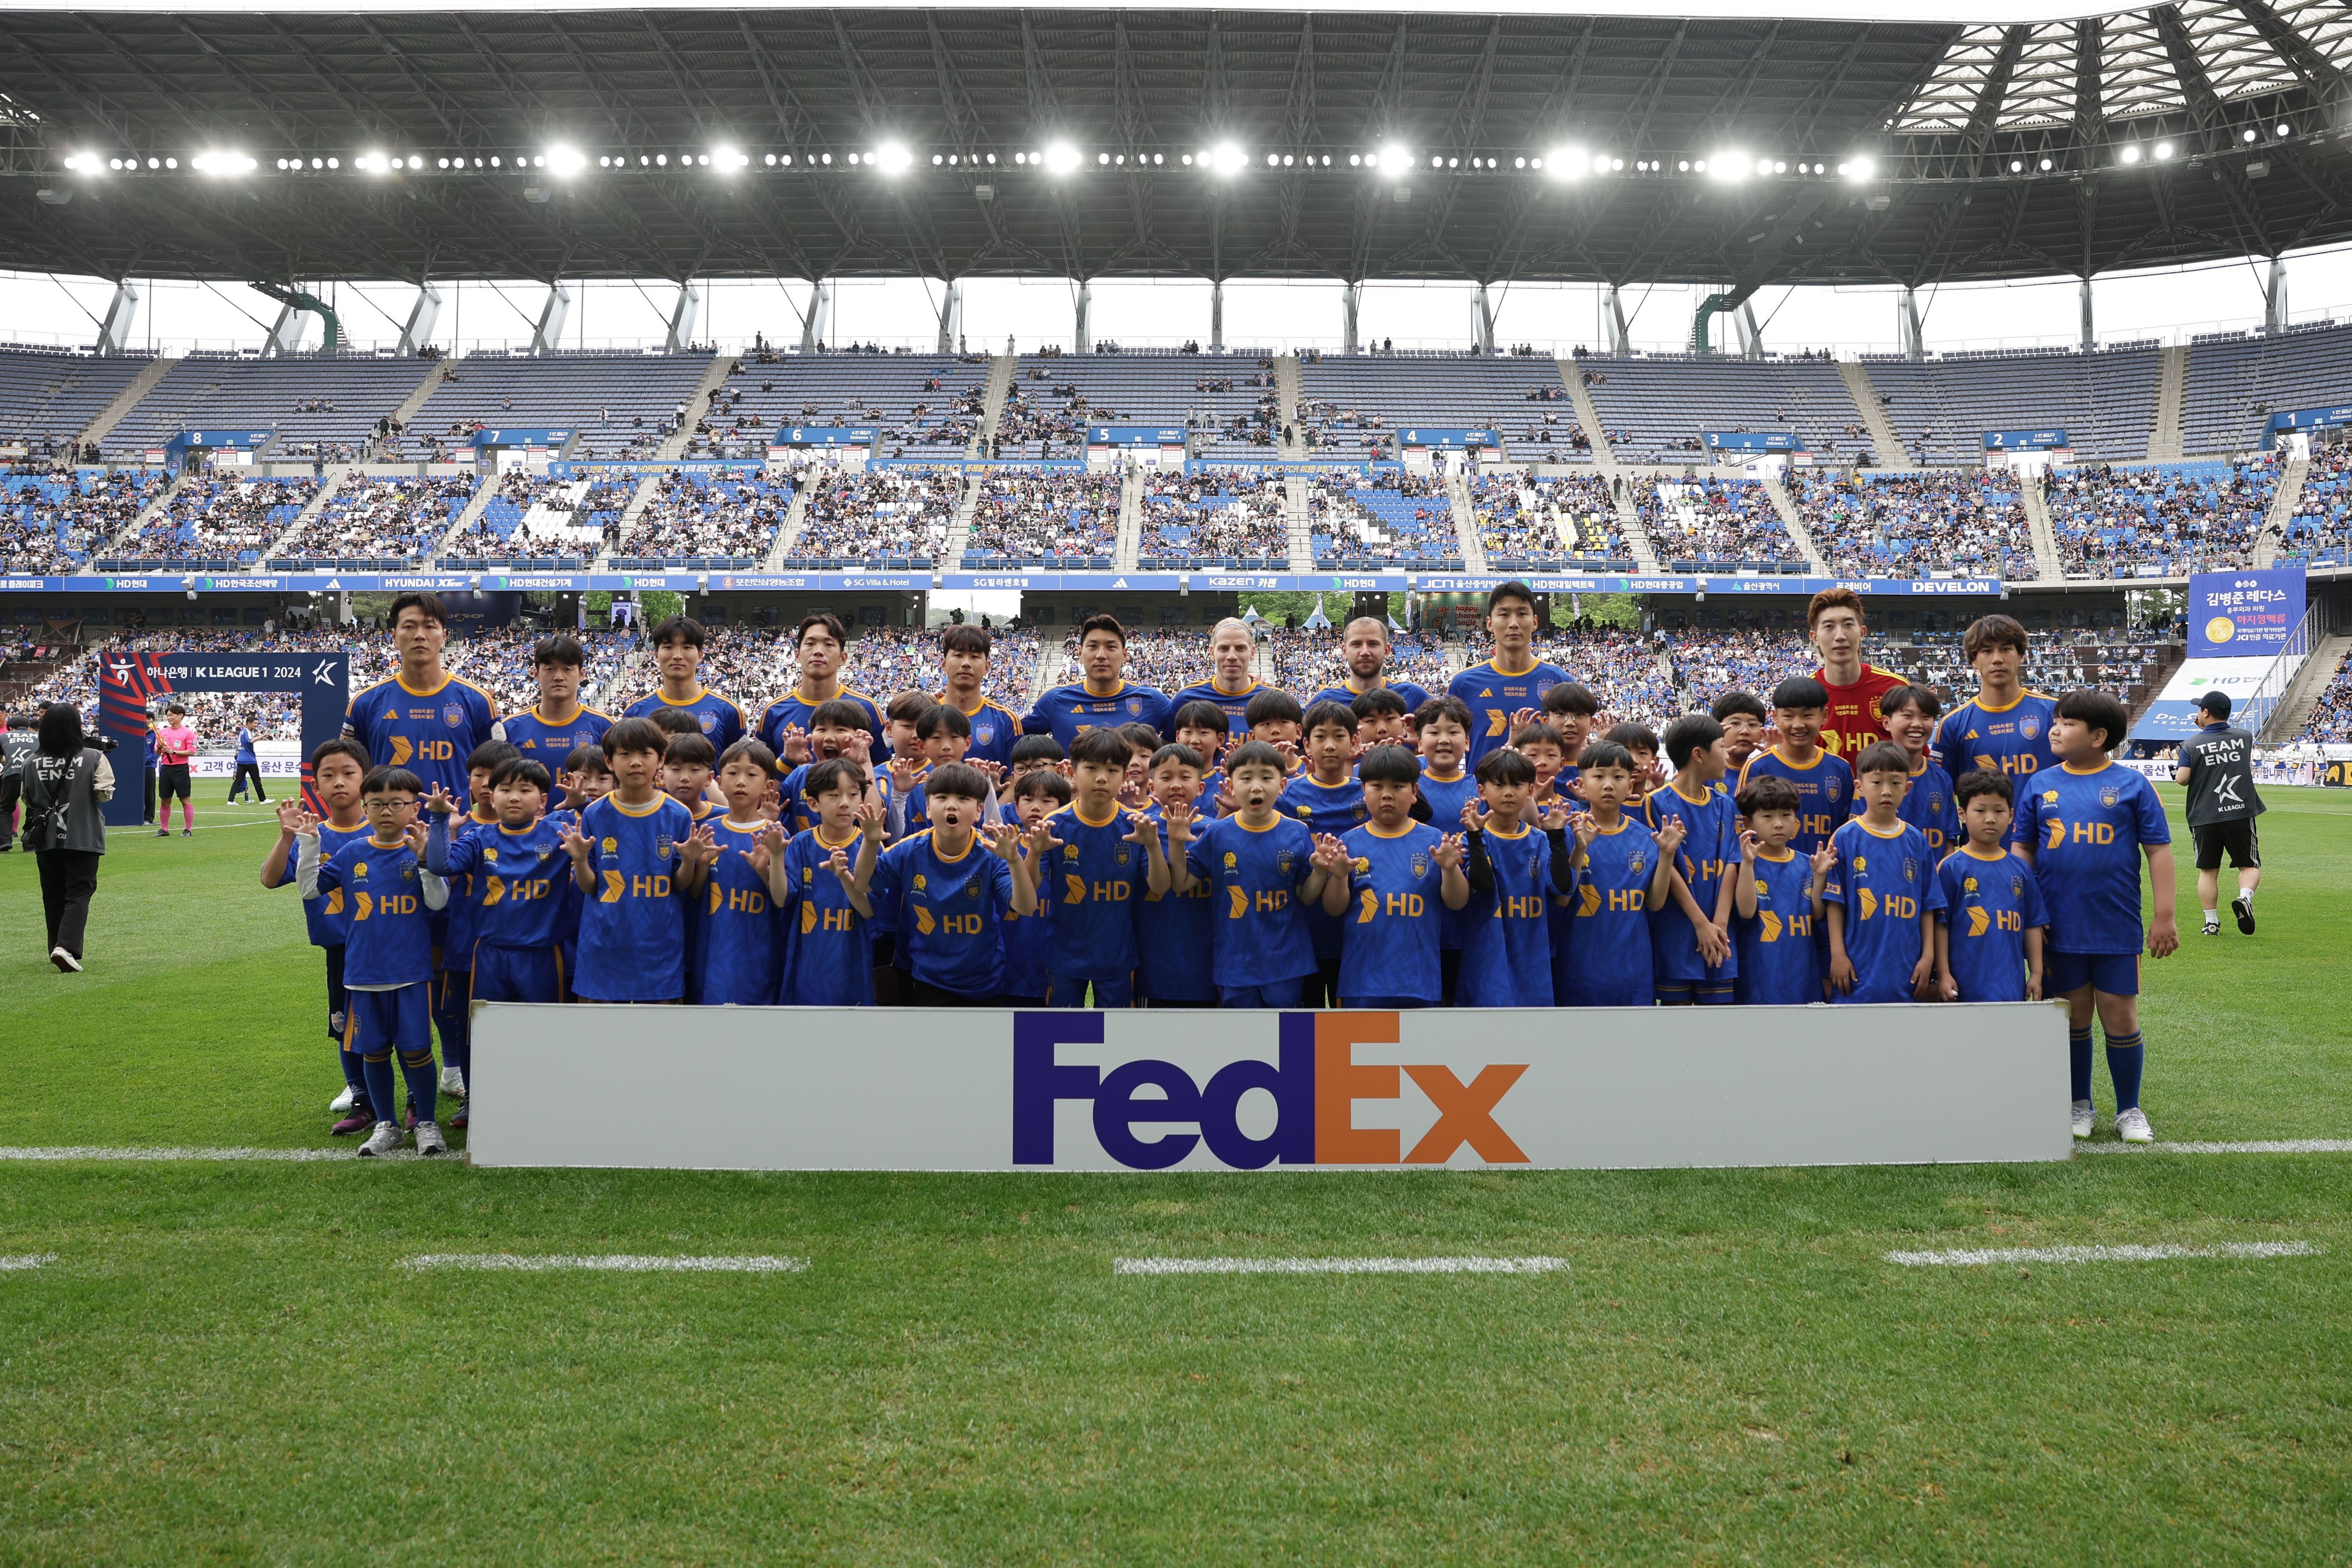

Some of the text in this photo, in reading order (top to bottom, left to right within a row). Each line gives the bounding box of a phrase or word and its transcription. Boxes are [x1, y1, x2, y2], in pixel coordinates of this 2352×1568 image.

[2288, 413, 2296, 425] 1
[193, 432, 202, 444] 8
[491, 431, 500, 442] 7
[792, 429, 802, 441] 6
[1100, 429, 1109, 440] 5
[1407, 431, 1417, 442] 4
[1710, 434, 1719, 446] 3
[1994, 434, 2003, 445] 2
[117, 580, 147, 588] HD현대
[216, 579, 278, 588] HD한국조선해양
[385, 579, 434, 587] HYUNDAI
[510, 578, 572, 587] HD현대건설기계
[634, 578, 665, 587] HD현대
[973, 578, 1028, 587] SG빌라앤호텔
[1257, 578, 1278, 588] 카젠
[1344, 579, 1376, 588] HD현대
[1533, 580, 1595, 589] HD현대일렉트릭
[1631, 580, 1683, 589] HD현대중공업
[1743, 582, 1780, 591] 울산광역시
[1912, 582, 1989, 592] DEVELON
[2206, 589, 2287, 606] 김병준 레다스
[1455, 604, 1478, 612] happy
[2237, 613, 2287, 625] 하지정맥류
[147, 666, 301, 679] 하나은행 K LEAGUE 1 2024
[1846, 732, 1880, 753] HD
[2195, 738, 2245, 755] TEAM
[419, 741, 454, 760] HD
[32, 756, 84, 769] TEAM
[2003, 754, 2038, 775] HD
[2204, 751, 2241, 766] ENG
[203, 761, 223, 772] 고객
[261, 761, 282, 773] 울산
[2143, 764, 2166, 776] 울산
[37, 768, 75, 781] ENG
[1804, 815, 1831, 835] HD
[2074, 823, 2115, 845] HD
[1702, 859, 1724, 881] HD
[513, 880, 550, 901] HD
[634, 876, 672, 898] HD
[1095, 881, 1131, 901] HD
[381, 896, 417, 915] HD
[730, 889, 764, 914] HD
[1257, 891, 1288, 912] HD
[1388, 894, 1424, 917] HD
[1610, 890, 1646, 911] HD
[1886, 895, 1916, 919] HD
[1509, 897, 1543, 918] HD
[824, 909, 853, 931] HD
[944, 915, 983, 934] HD
[1998, 910, 2020, 932] HD
[1013, 1011, 1531, 1170] FedEx
